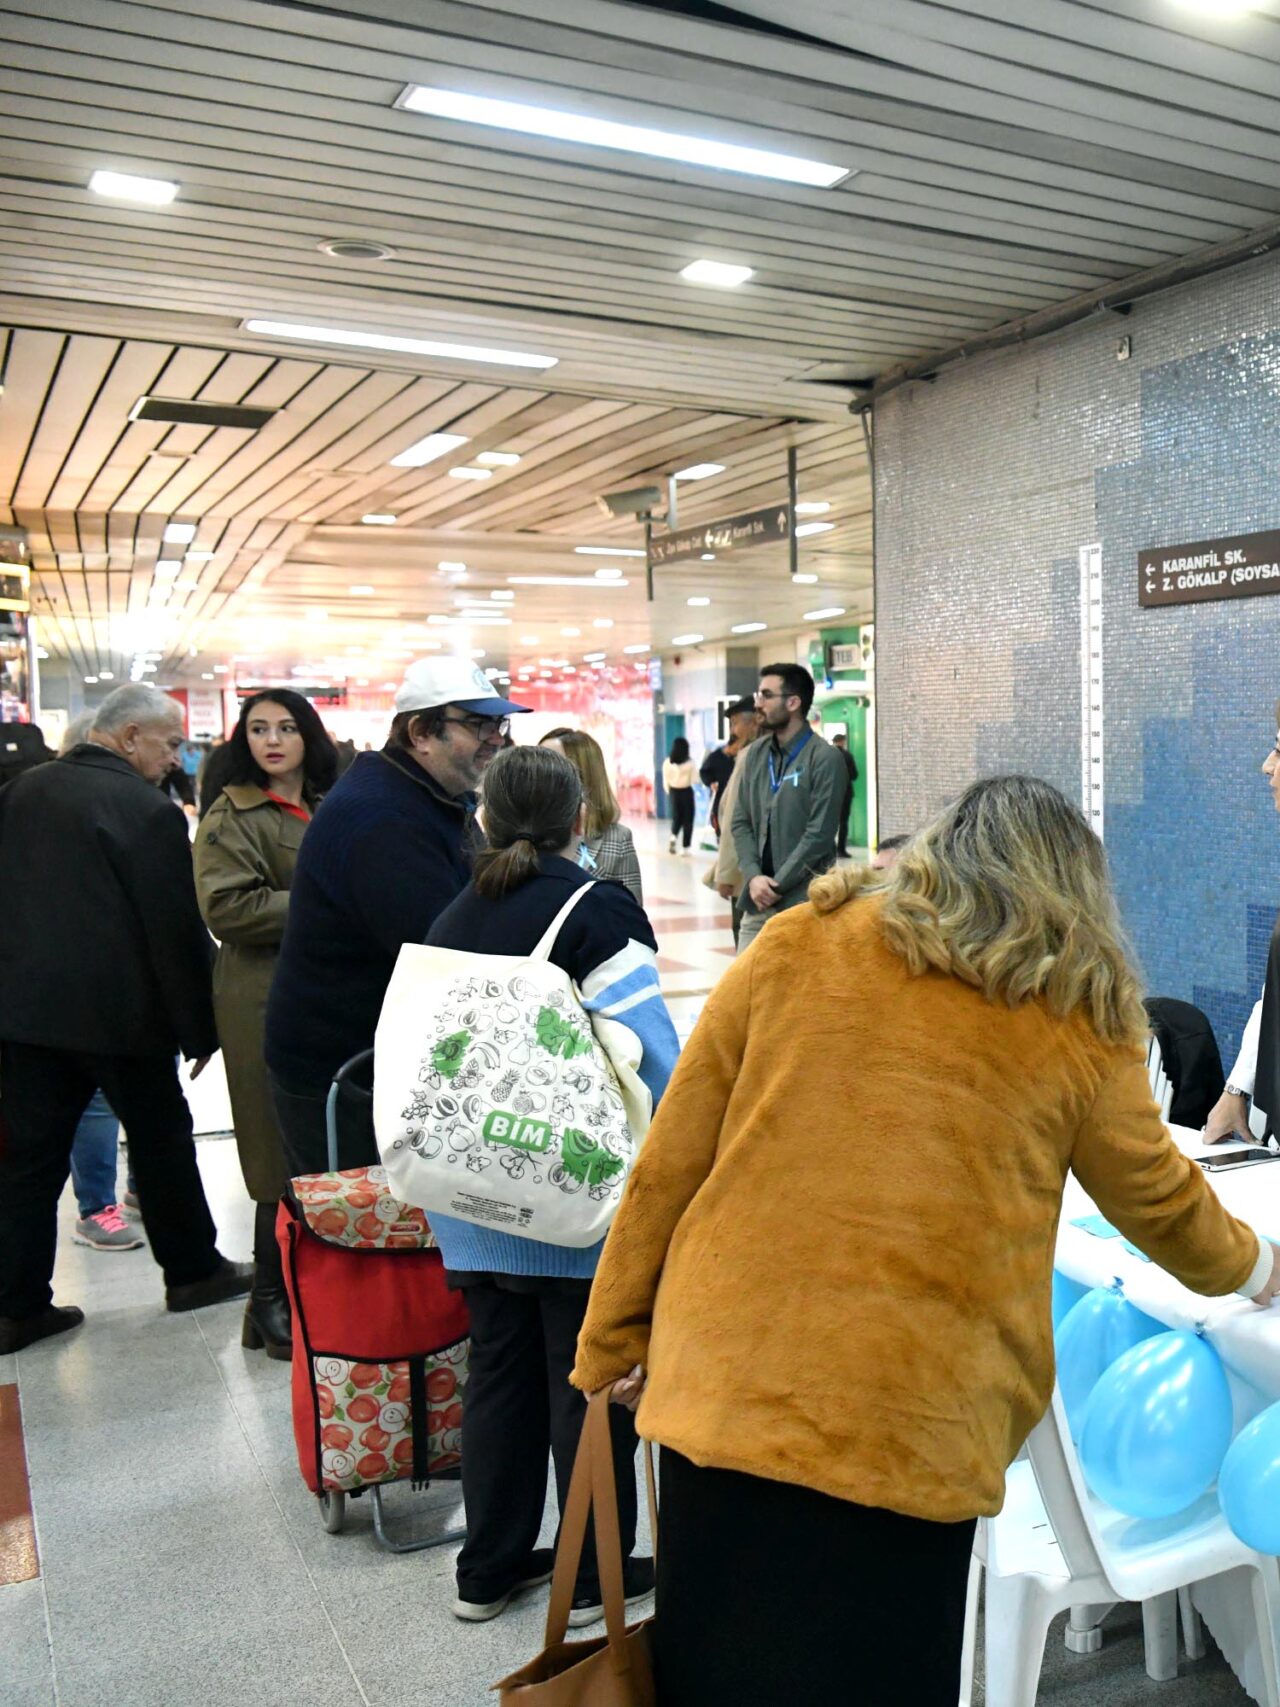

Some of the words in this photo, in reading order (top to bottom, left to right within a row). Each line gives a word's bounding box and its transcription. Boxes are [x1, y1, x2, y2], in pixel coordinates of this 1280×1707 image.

[1162, 550, 1221, 574] KARANFİL
[1224, 548, 1247, 565] SK.
[1162, 576, 1174, 591] Z.
[1177, 568, 1228, 590] GÖKALP
